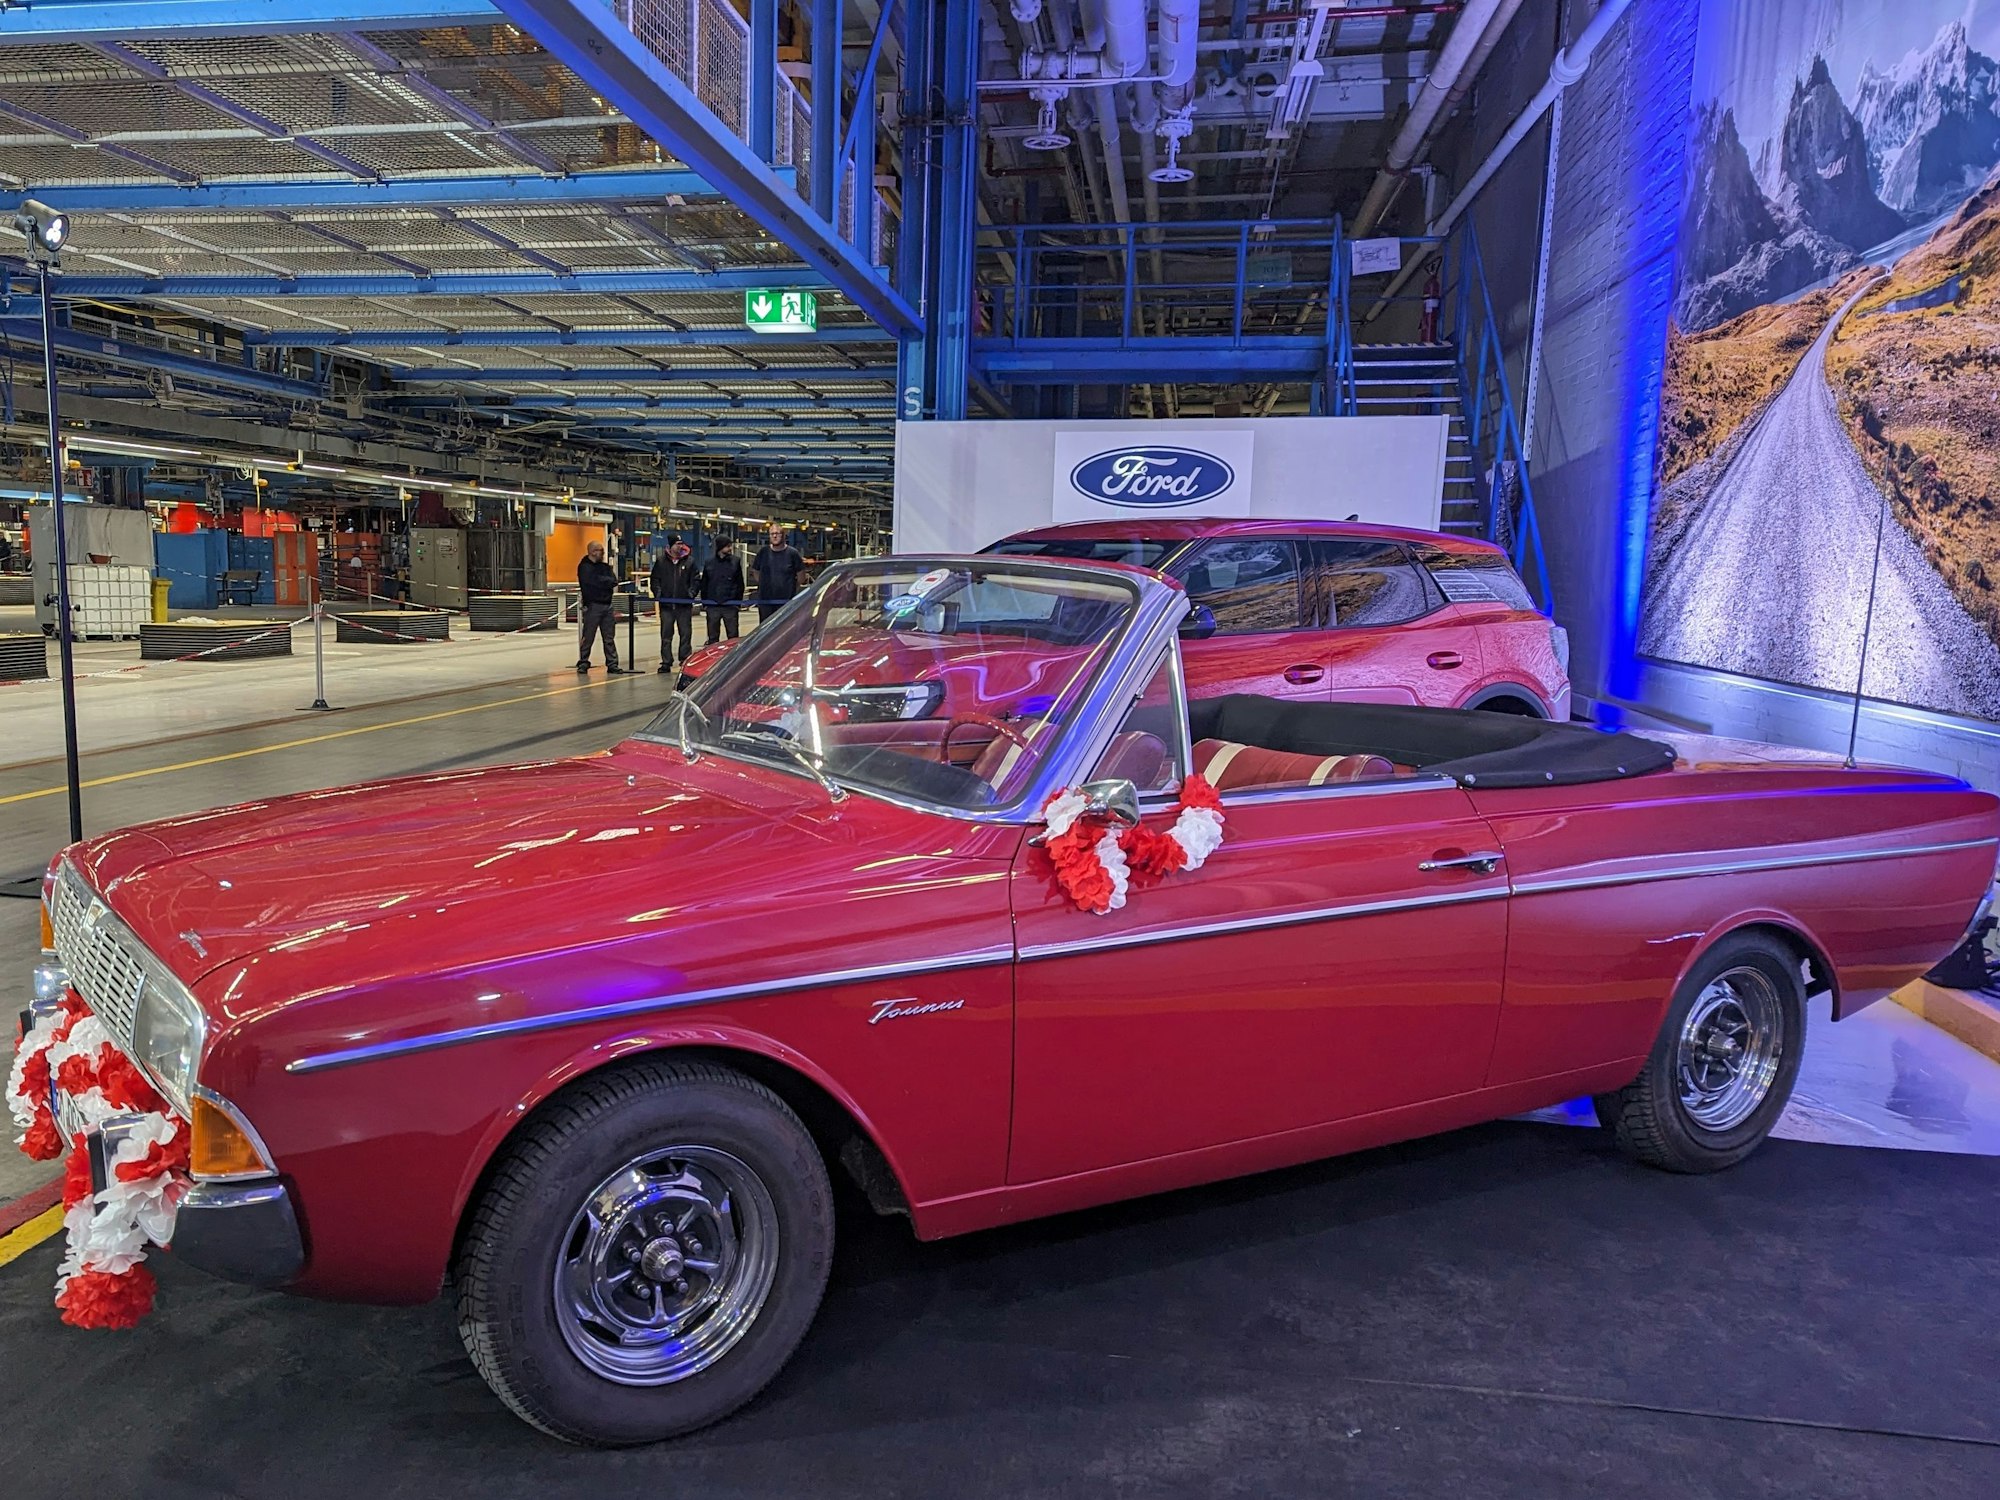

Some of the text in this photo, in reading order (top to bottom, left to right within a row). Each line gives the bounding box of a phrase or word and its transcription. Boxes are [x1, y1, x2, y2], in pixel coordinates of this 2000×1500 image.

[903, 386, 921, 416] S
[1101, 455, 1203, 496] Ford
[867, 997, 965, 1025] Taunus
